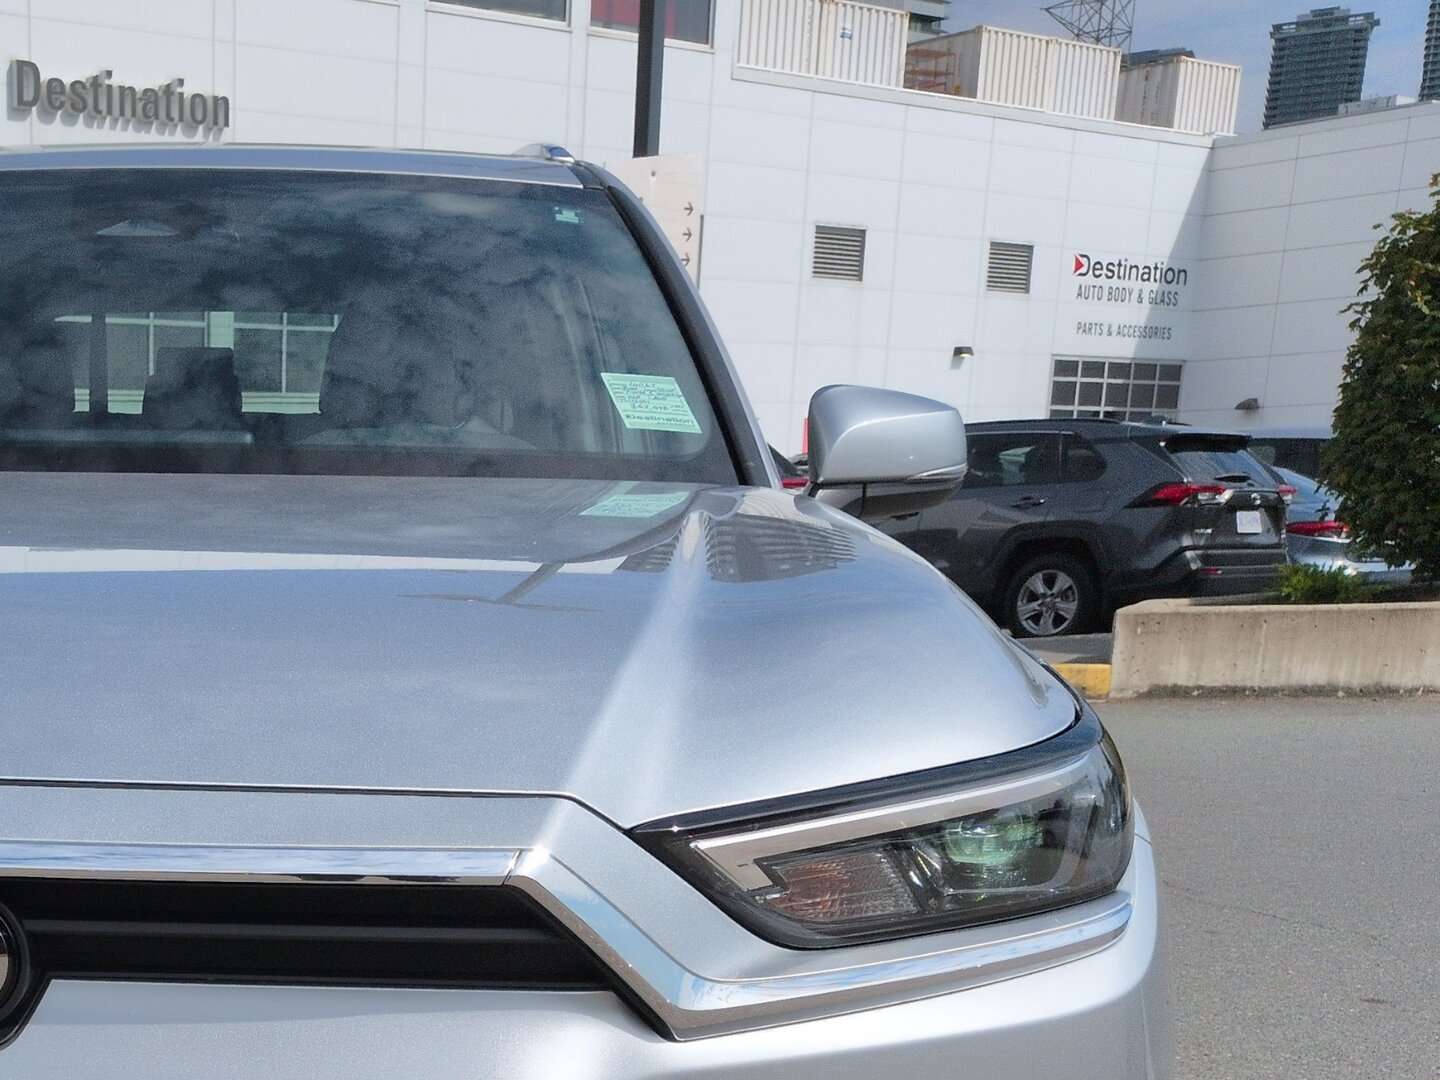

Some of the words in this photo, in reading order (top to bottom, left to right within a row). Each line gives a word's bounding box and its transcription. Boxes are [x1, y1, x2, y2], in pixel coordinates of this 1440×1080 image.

[9, 59, 230, 129] Destination
[1073, 253, 1188, 286] Destination
[1076, 285, 1103, 300] AUTO
[1107, 286, 1134, 303] BODY
[1136, 288, 1144, 305] &
[1148, 289, 1179, 307] GLASS
[1076, 321, 1104, 337] PARTS
[1106, 324, 1113, 337] &
[1115, 324, 1173, 340] ACCESSORIES
